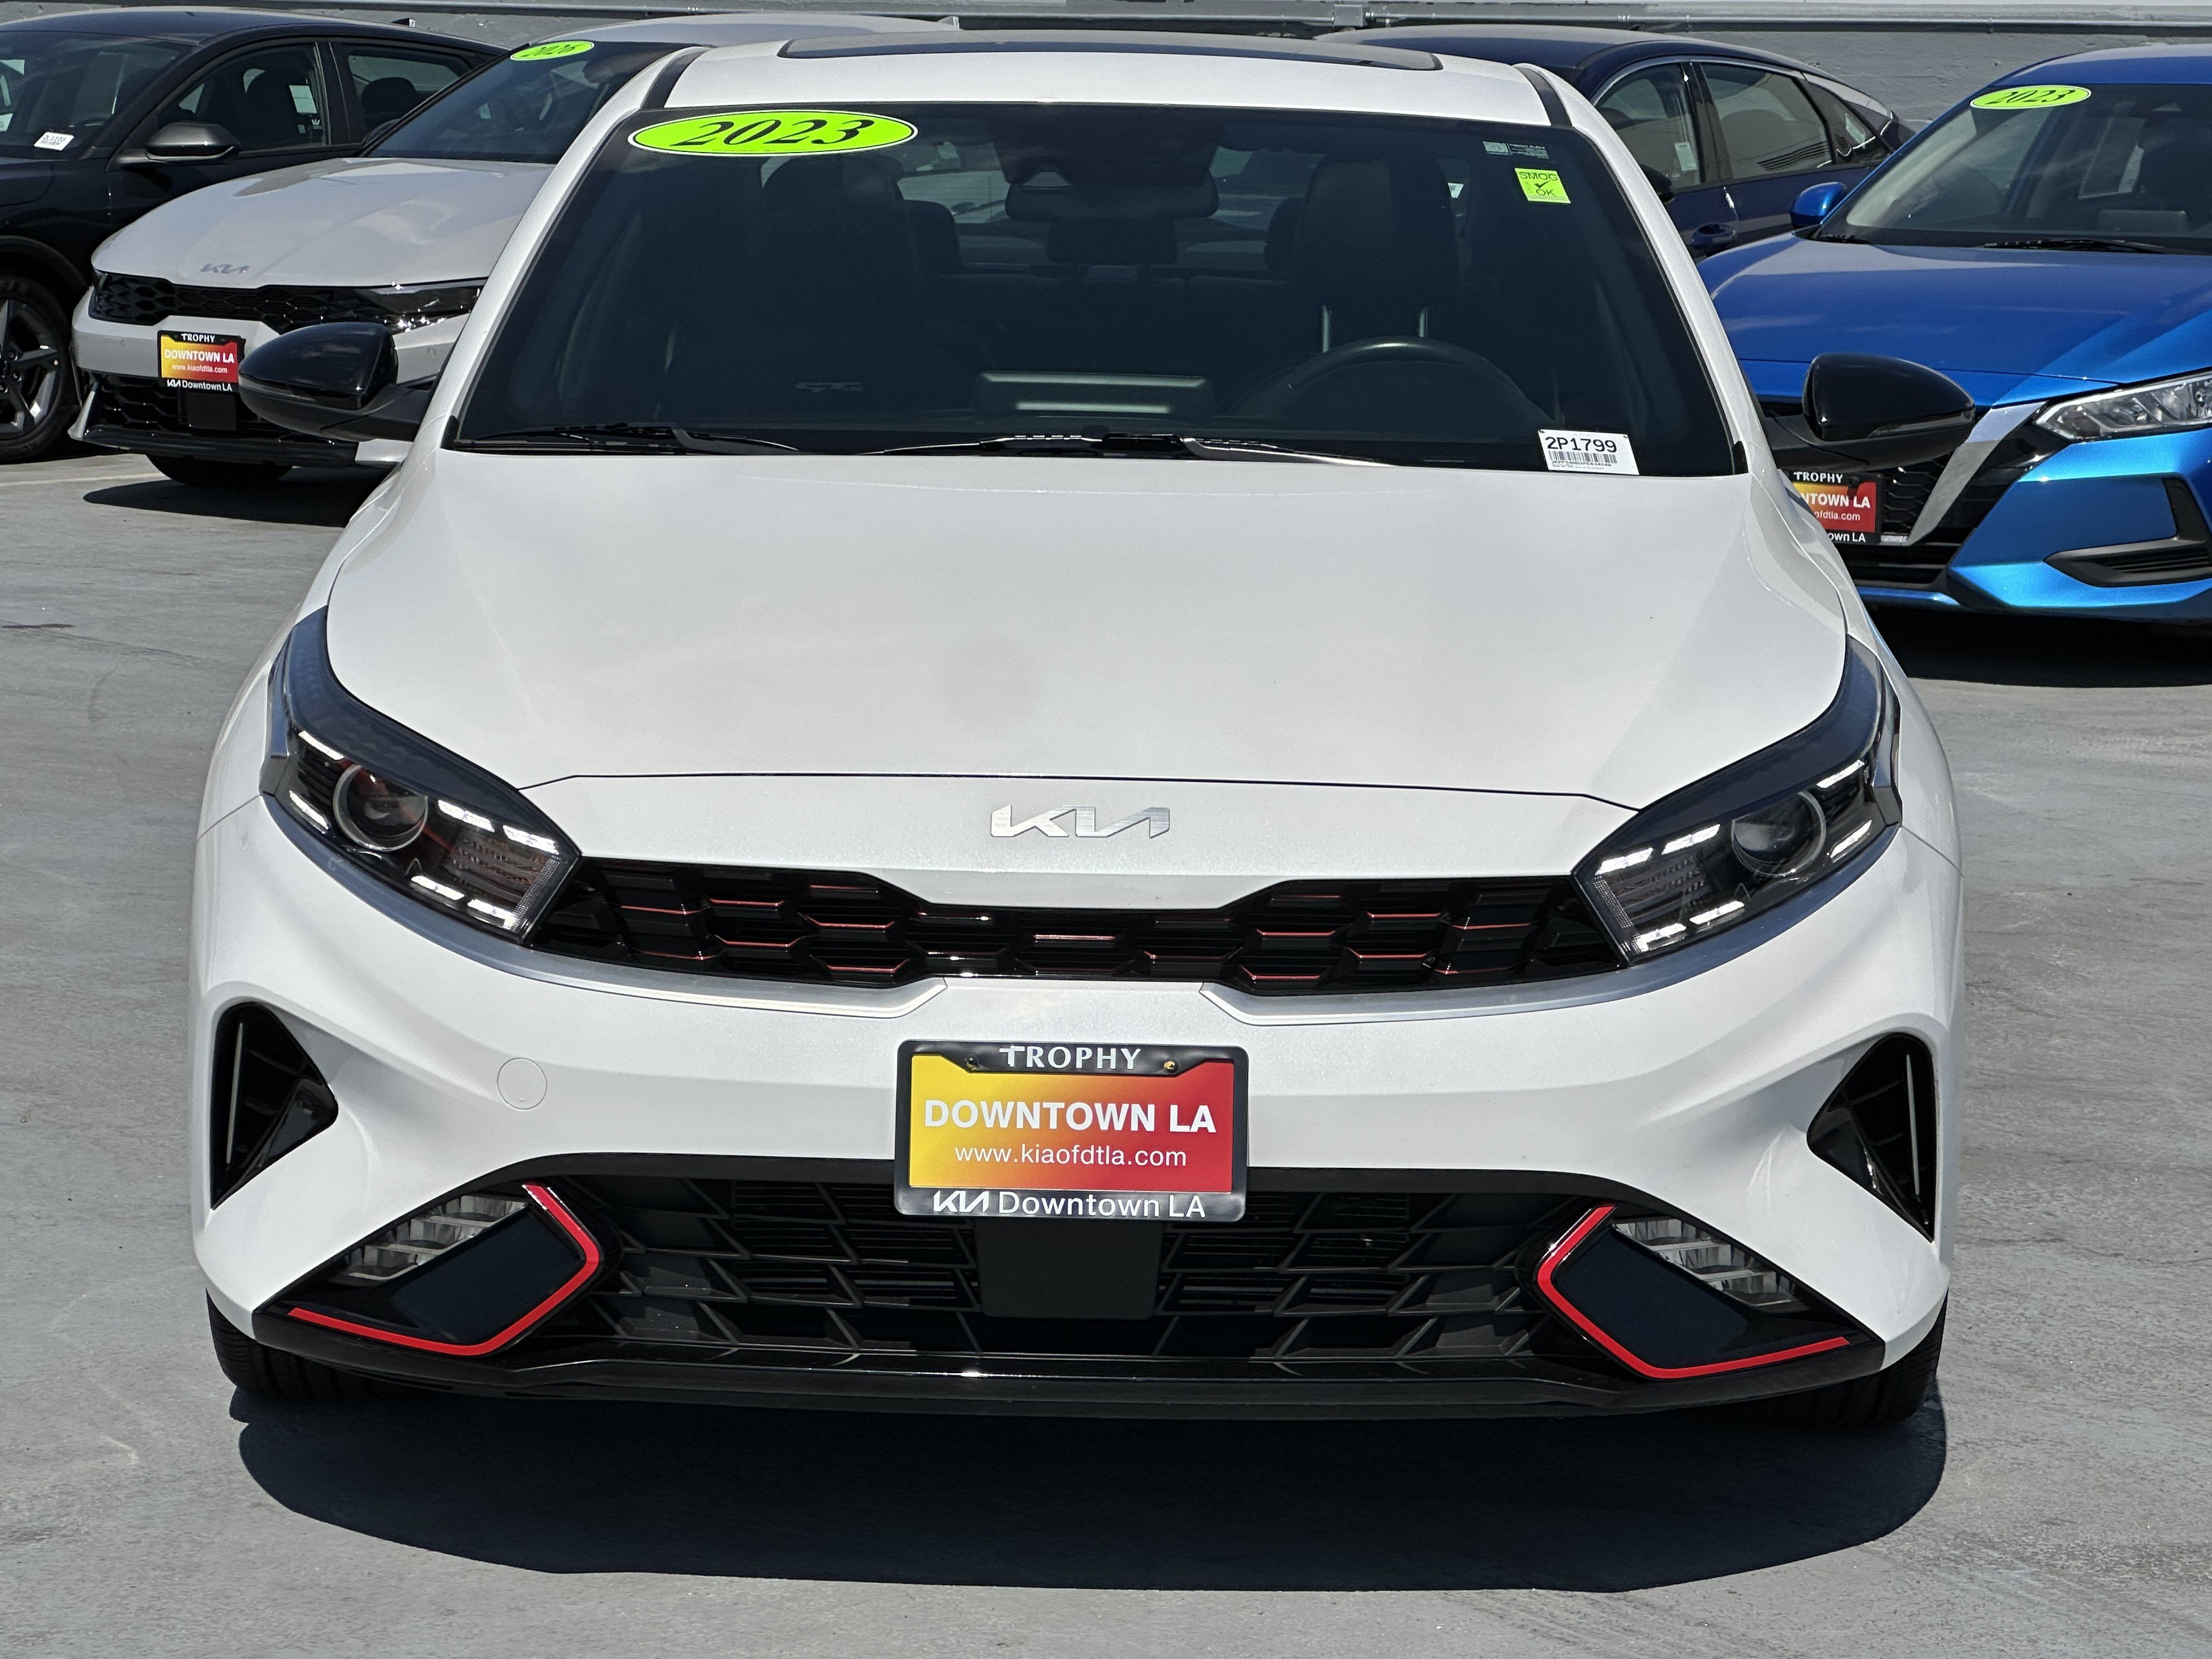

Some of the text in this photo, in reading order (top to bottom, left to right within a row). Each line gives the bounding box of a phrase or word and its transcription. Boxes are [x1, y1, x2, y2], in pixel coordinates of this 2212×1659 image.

[1984, 89, 2076, 105] 2023
[669, 119, 875, 146] 2023
[1518, 171, 1558, 181] SMOG
[181, 333, 215, 343] TROPHY
[165, 349, 234, 363] DOWNTOWN LA
[172, 364, 228, 374] www.kiaofdtla.com
[182, 380, 222, 391] Downtown
[222, 383, 233, 391] LA
[1545, 436, 1617, 453] 2P1799
[1793, 471, 1843, 483] TROPHY
[1800, 493, 1871, 508] NTOWN LA
[1814, 510, 1860, 521] ofdtla.com
[1852, 532, 1865, 542] LA
[991, 804, 1170, 839] KIA
[1000, 1046, 1141, 1070] TROPHY
[925, 1099, 1216, 1133] DOWNTOWN LA
[955, 1144, 1186, 1166] www.kiaofdtla.com
[934, 1190, 1206, 1218] KIA Downtown LA
